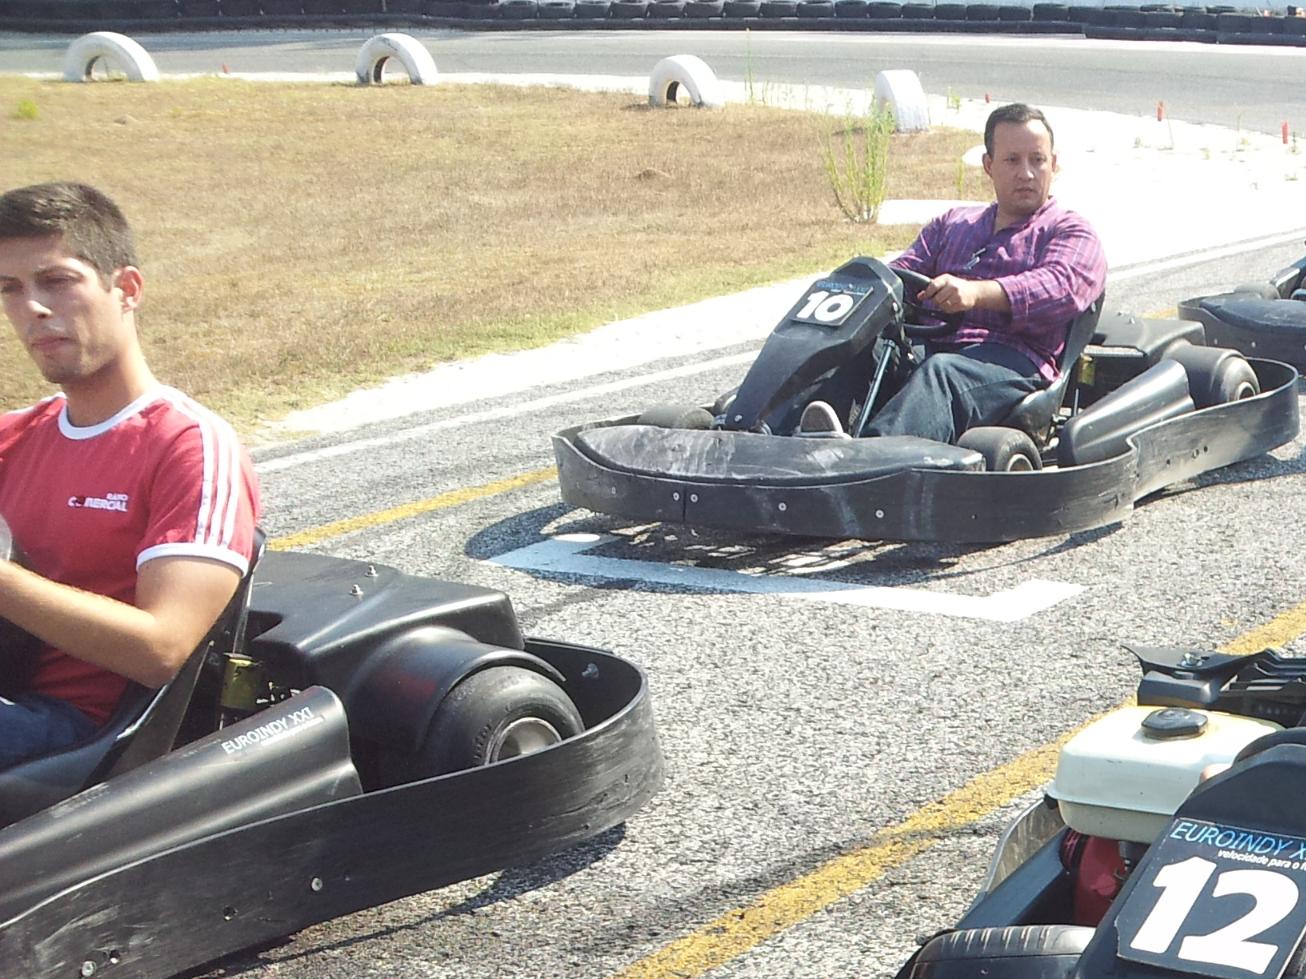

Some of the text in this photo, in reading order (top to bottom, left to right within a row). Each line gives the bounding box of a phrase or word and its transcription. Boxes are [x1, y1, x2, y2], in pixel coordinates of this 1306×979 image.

[796, 290, 854, 322] 10
[221, 717, 290, 754] EUROINDY
[288, 707, 316, 726] XXI
[1170, 822, 1292, 853] EUROINDY
[1217, 849, 1269, 865] velocidade
[1267, 857, 1292, 868] para
[1292, 861, 1300, 870] o
[1130, 855, 1300, 975] 12
